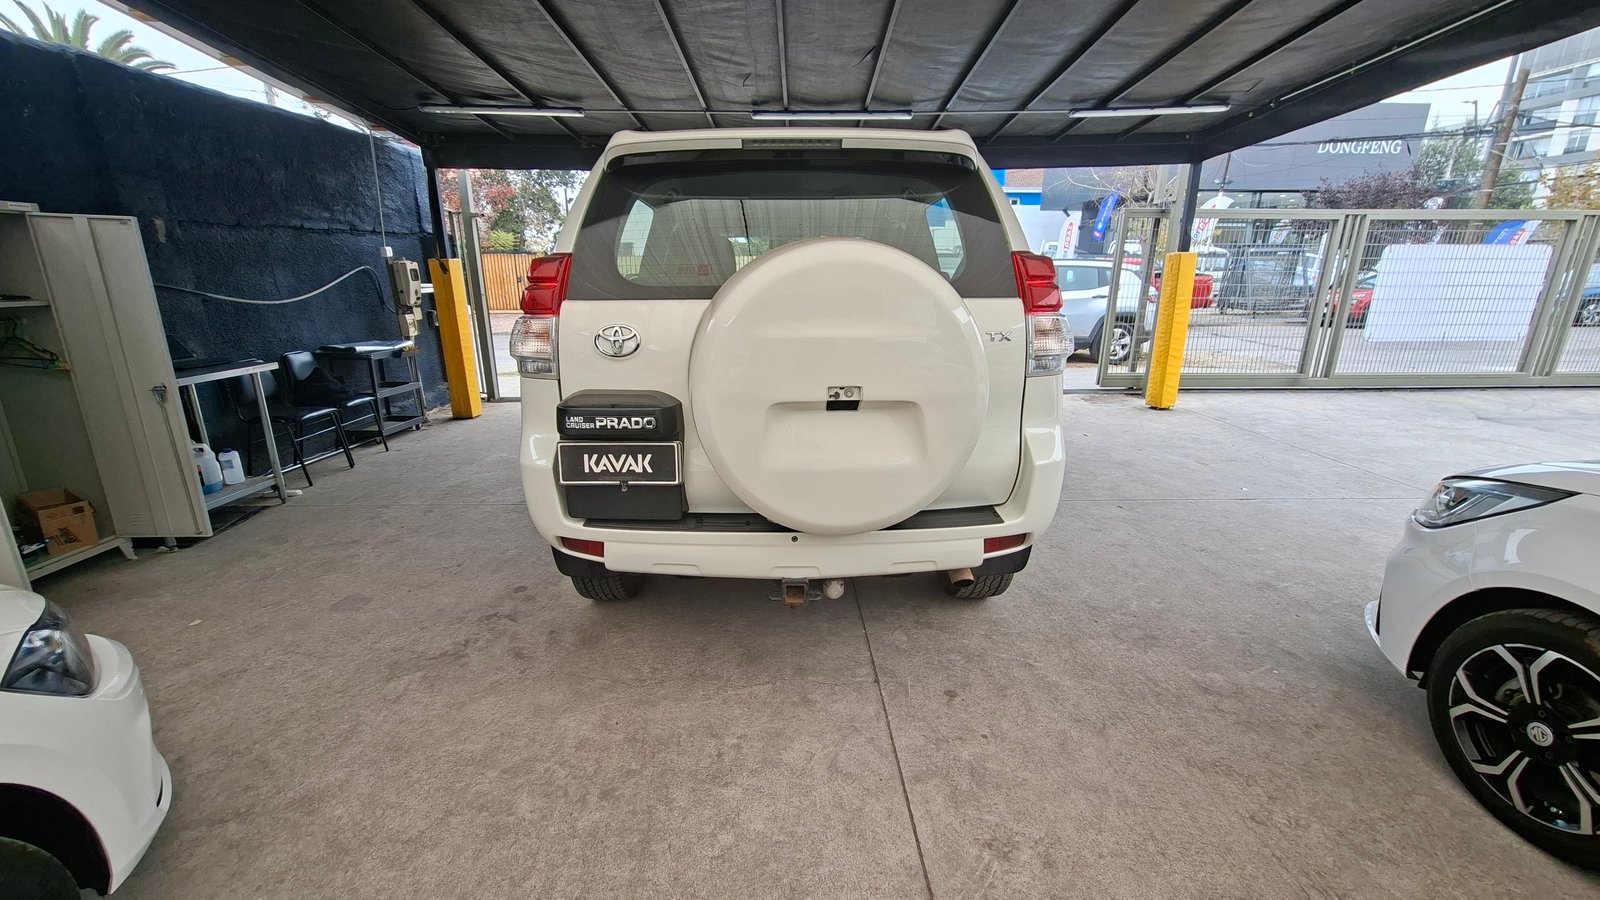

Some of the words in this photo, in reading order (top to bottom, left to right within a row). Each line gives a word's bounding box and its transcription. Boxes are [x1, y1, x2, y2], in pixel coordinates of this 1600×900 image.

[1317, 140, 1402, 154] DONGFENG
[986, 331, 1012, 342] TX
[595, 417, 657, 429] PRADO
[583, 454, 653, 473] KAVAK
